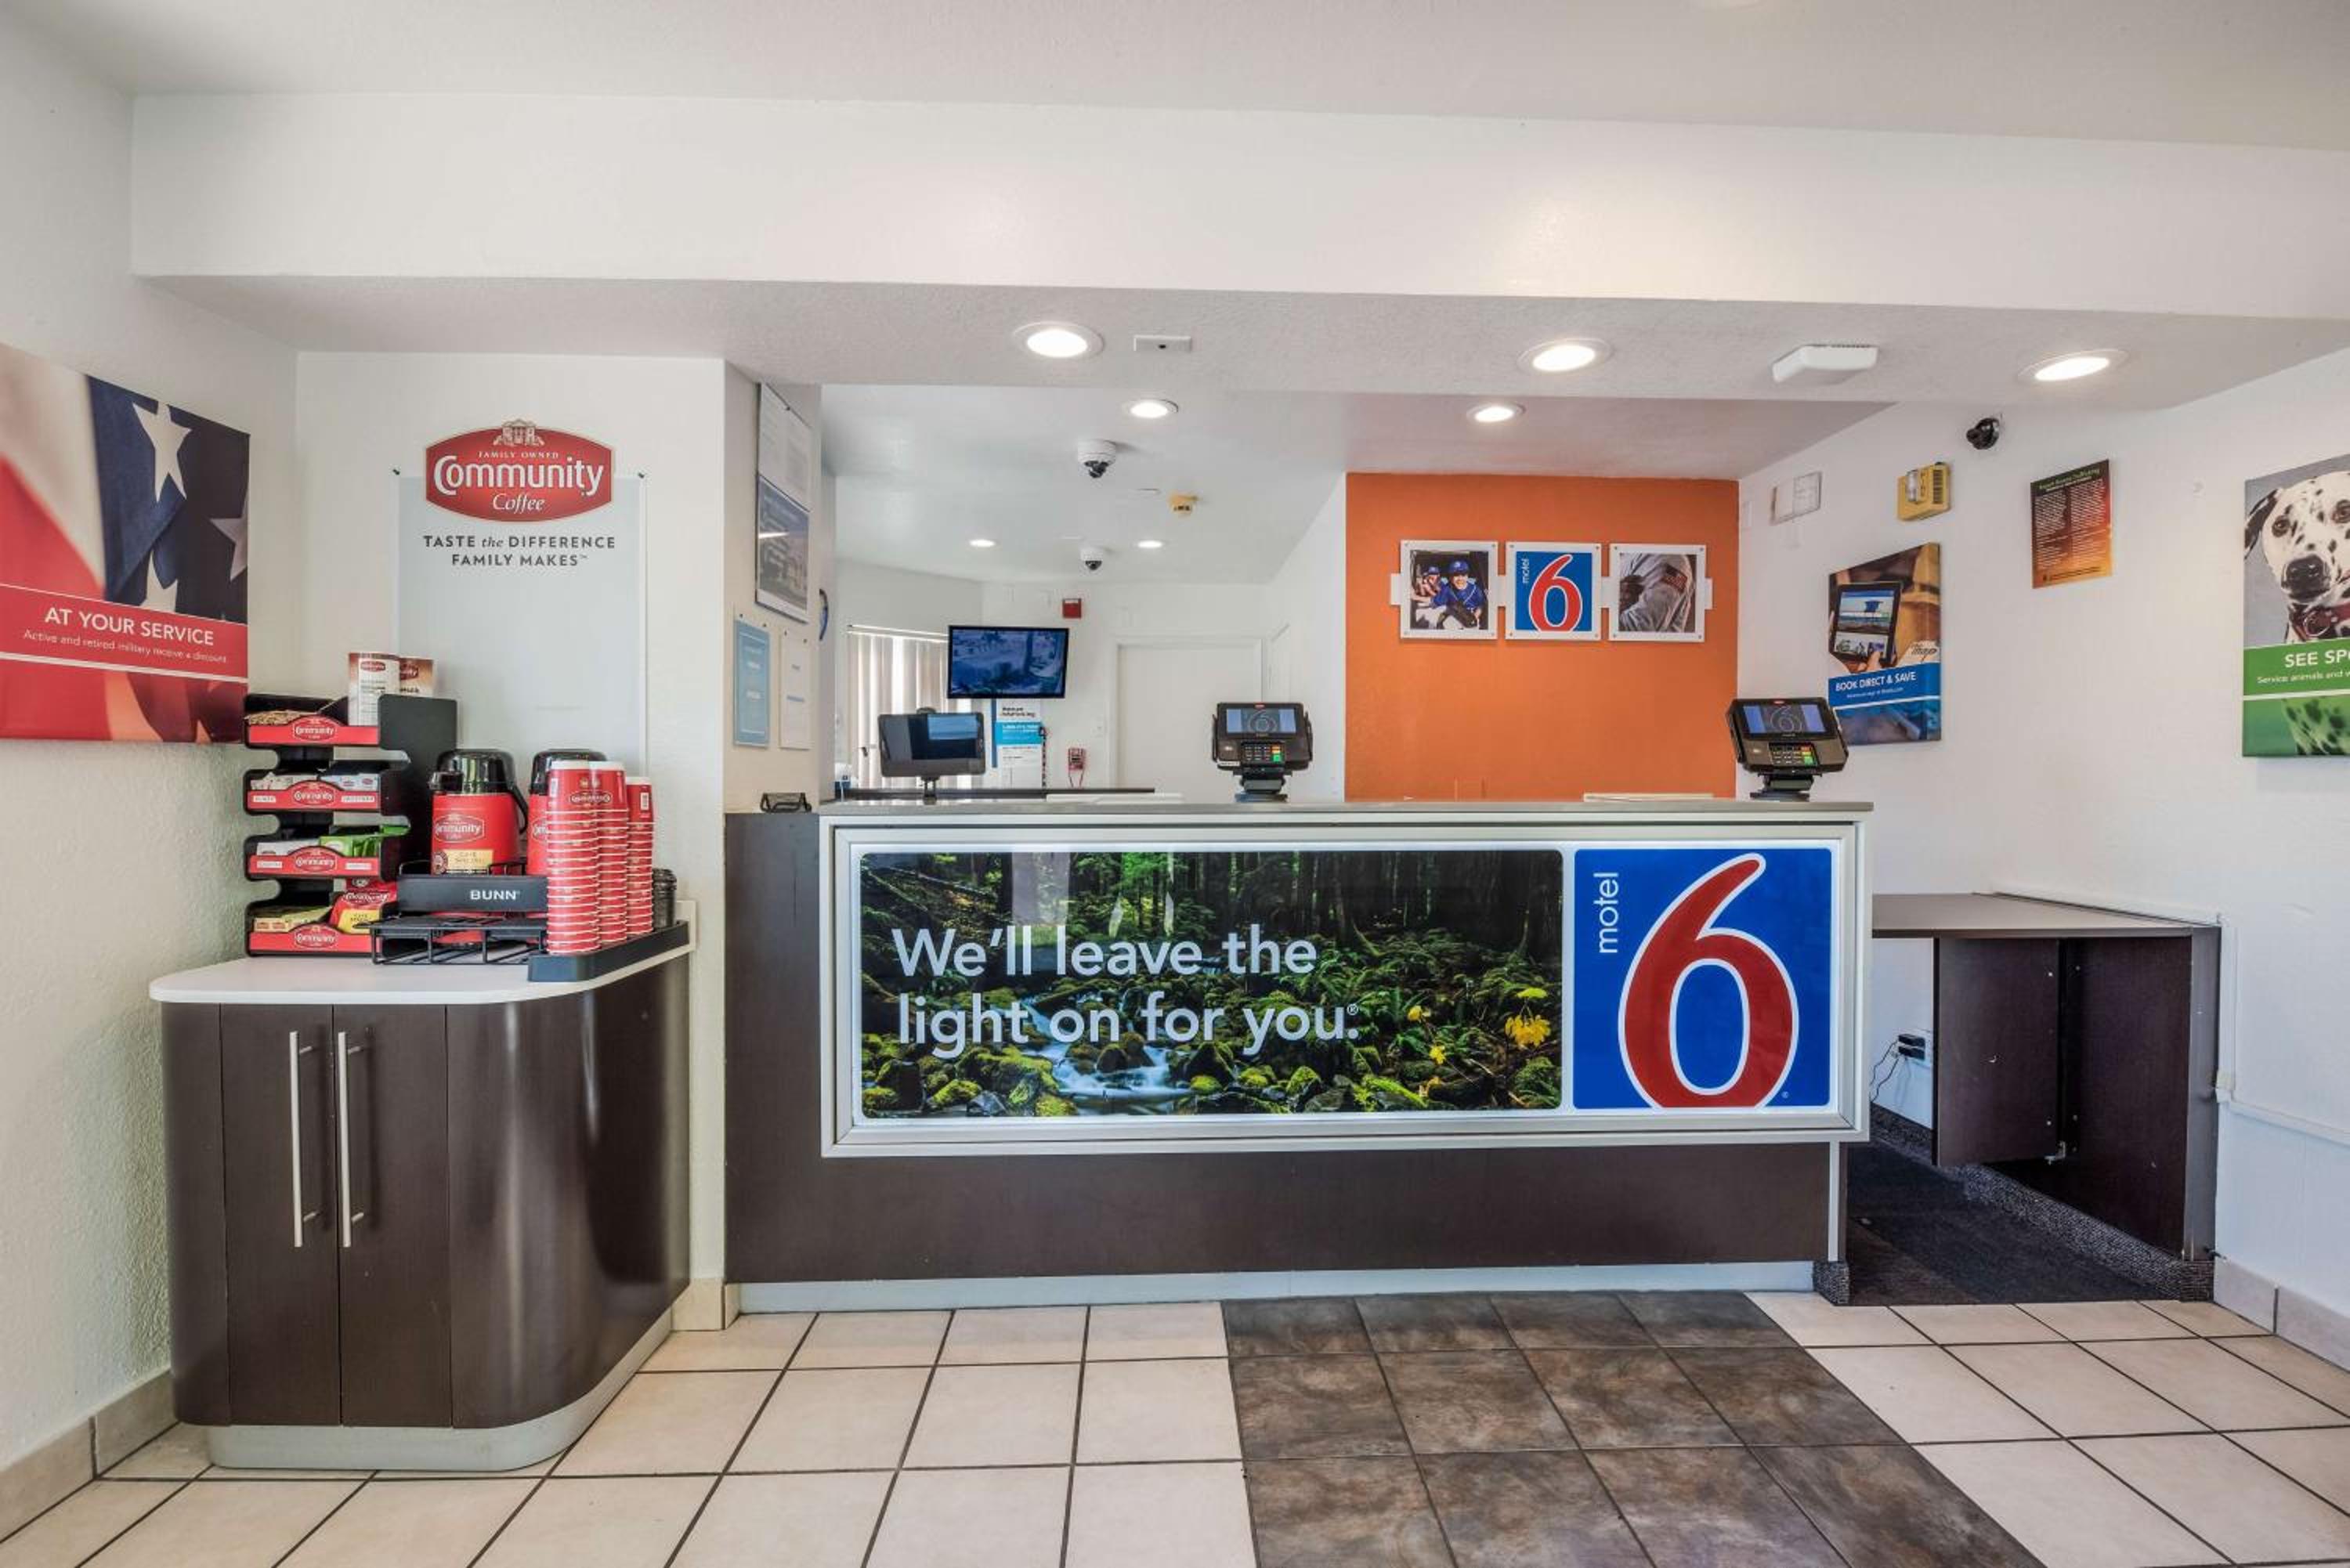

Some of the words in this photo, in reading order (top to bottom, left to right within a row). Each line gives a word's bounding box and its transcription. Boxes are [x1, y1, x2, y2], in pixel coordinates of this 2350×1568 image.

[433, 455, 603, 496] Community
[492, 493, 546, 515] Coffee
[423, 536, 475, 547] TASTE
[482, 536, 503, 547] the
[508, 536, 615, 548] DIFFERENCE
[452, 555, 513, 566] FAMILY
[1528, 554, 1583, 632] 6
[45, 607, 73, 626] AT
[79, 611, 135, 634] YOUR
[141, 621, 215, 645] SERVICE
[24, 629, 57, 643] Active
[60, 635, 81, 646] and
[83, 639, 115, 650] retired
[118, 643, 152, 656] military
[154, 648, 183, 659] receive
[192, 653, 226, 663] discount
[2285, 652, 2319, 668] SEE
[1835, 681, 1858, 692] BOOK
[1860, 677, 1884, 688] DIRECT
[1895, 672, 1916, 683] SAVE
[2257, 675, 2289, 684] Service
[2290, 671, 2323, 682] animals
[2326, 670, 2343, 680] and
[470, 890, 516, 900] BUNN
[1593, 873, 1618, 953] motel
[891, 925, 1032, 977] We'll
[1058, 925, 1202, 977] leave
[1222, 923, 1317, 974] the
[1618, 852, 1799, 1108] 6
[899, 992, 1029, 1058] light
[1050, 1008, 1119, 1043] on
[1141, 991, 1224, 1042] for
